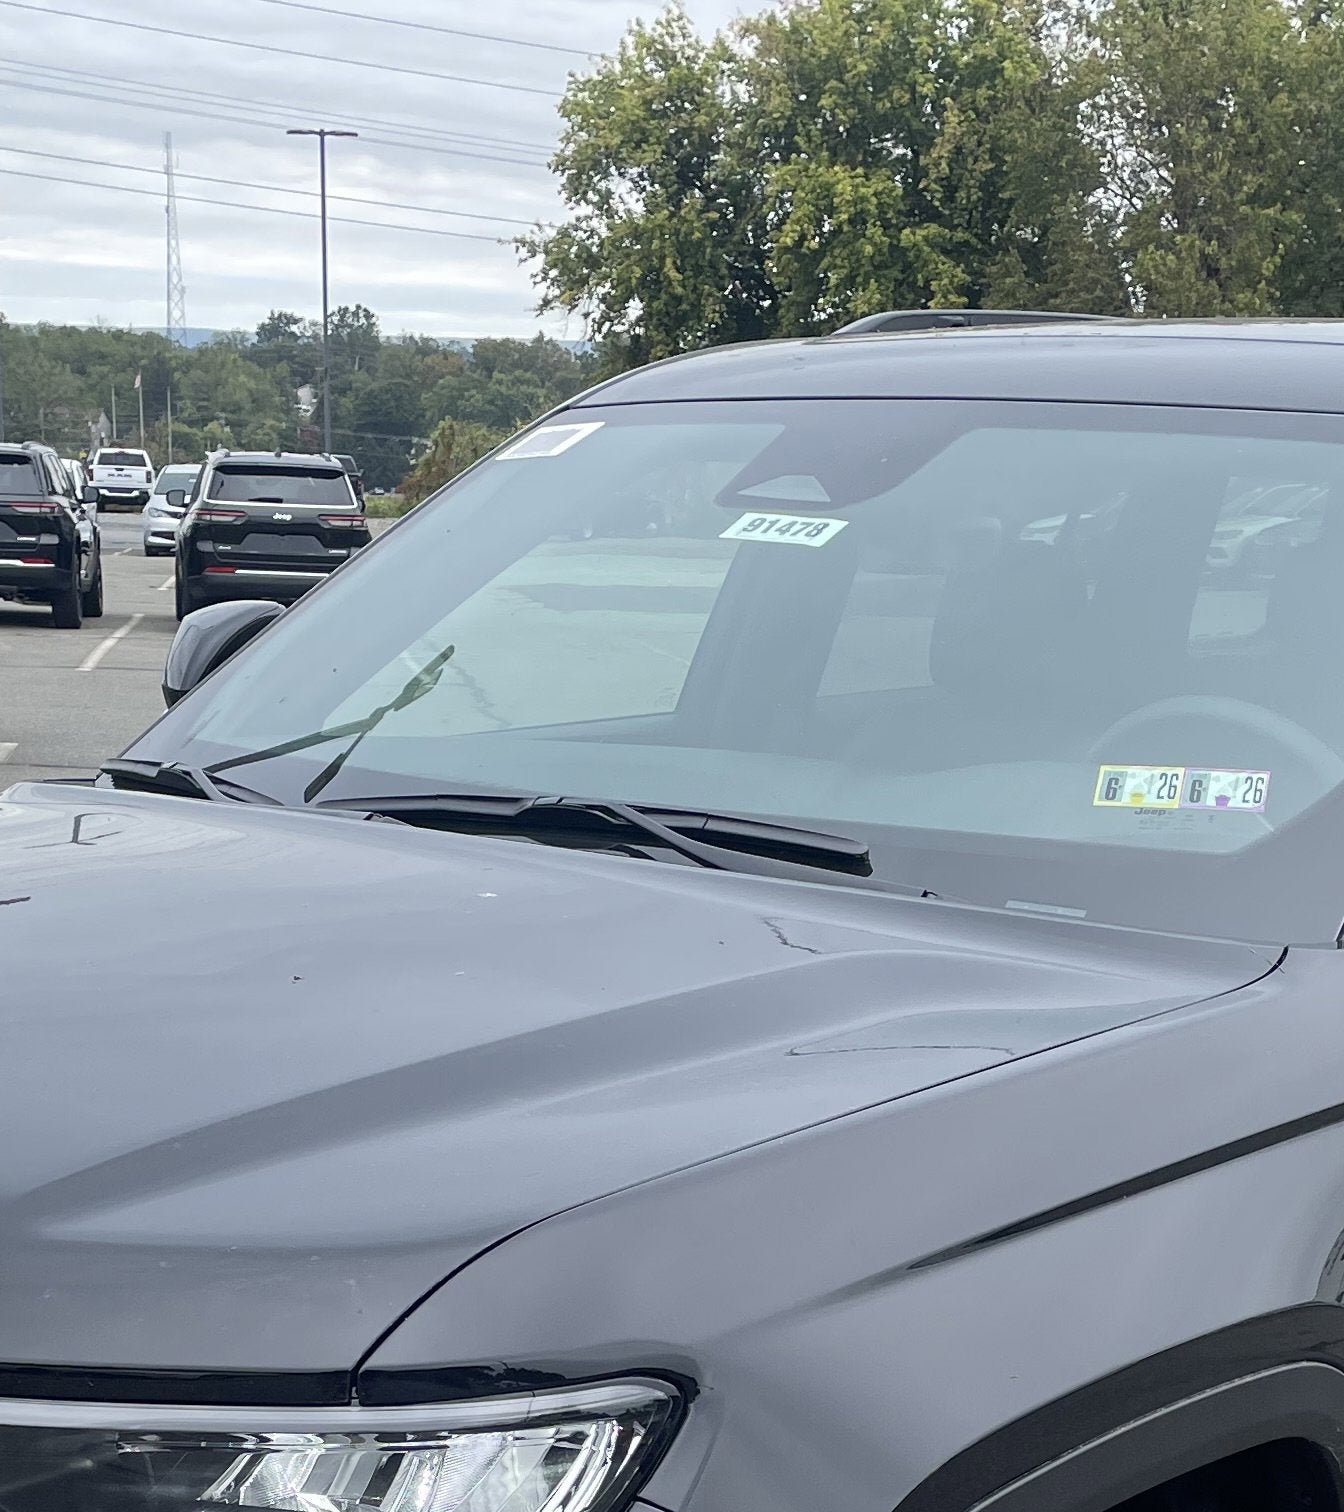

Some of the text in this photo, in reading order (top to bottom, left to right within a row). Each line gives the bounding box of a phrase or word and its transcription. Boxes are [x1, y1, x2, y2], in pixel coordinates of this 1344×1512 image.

[742, 517, 830, 538] 91478
[1104, 772, 1180, 801] 6 26
[1188, 776, 1265, 804] 6 26
